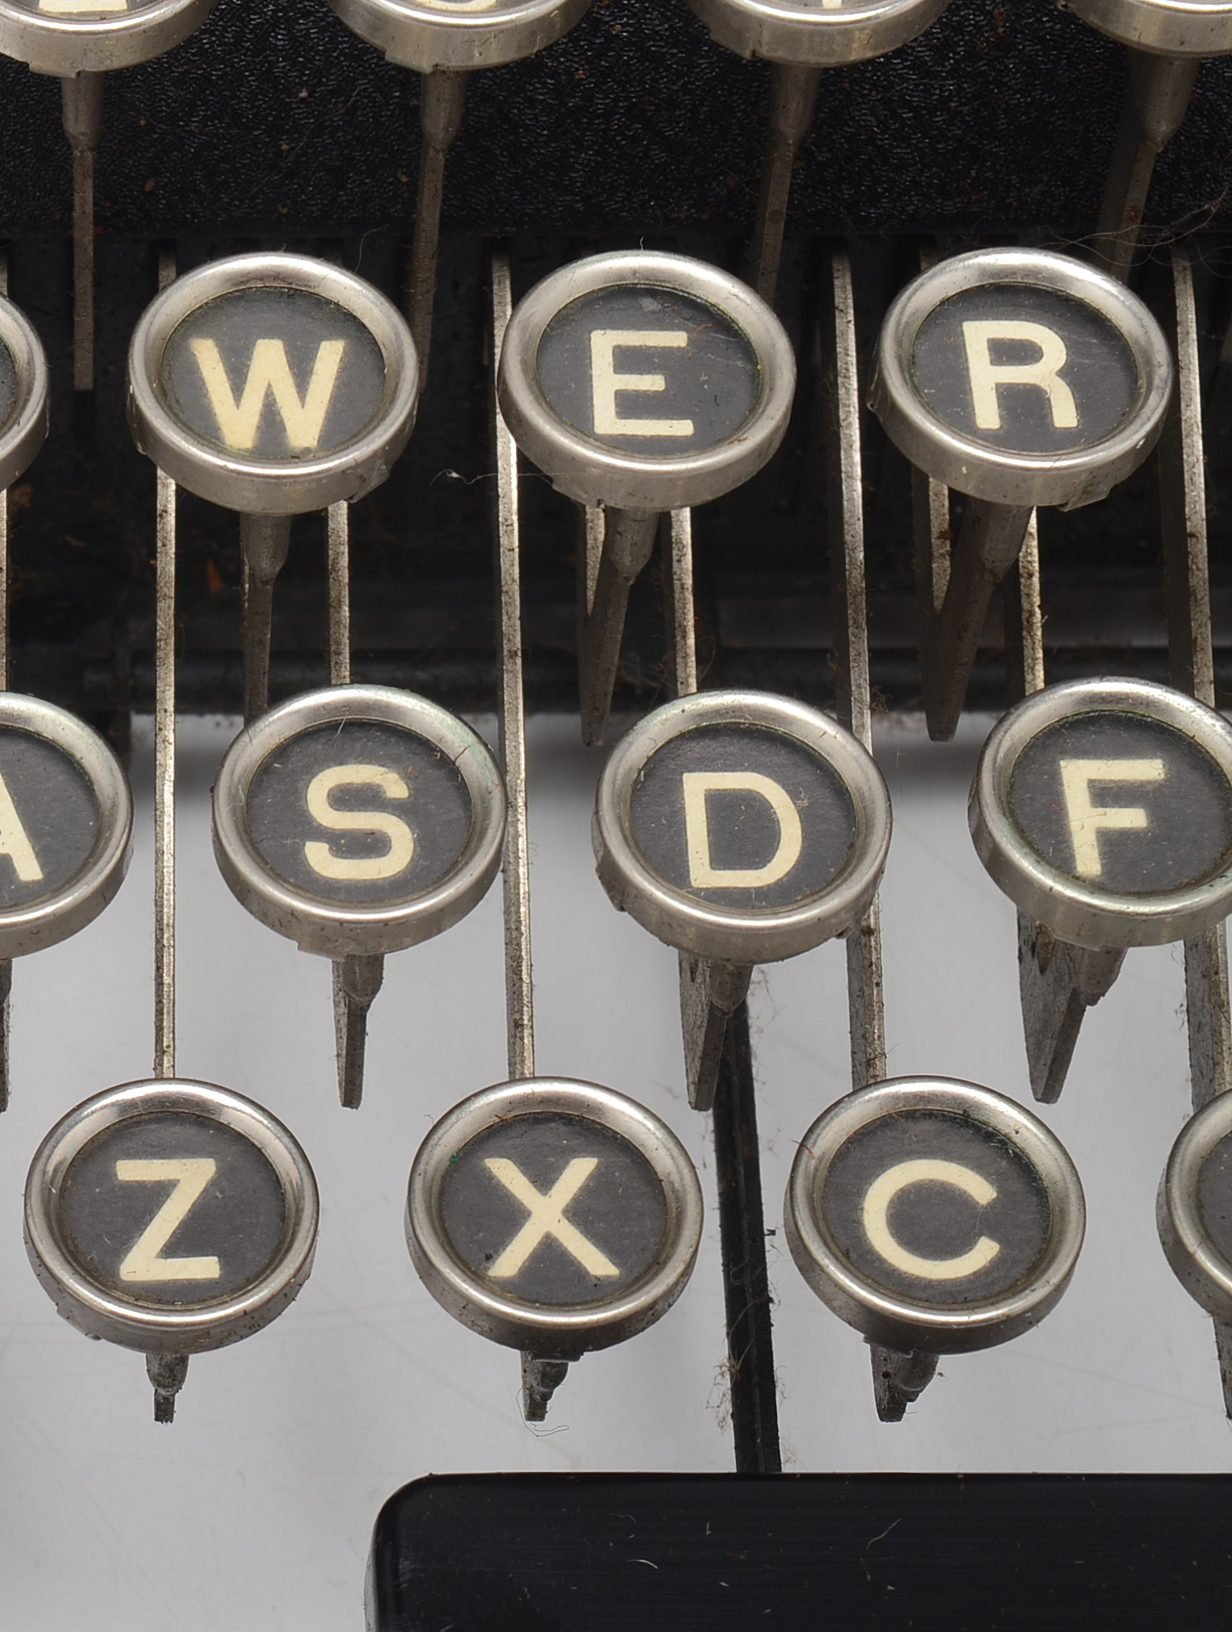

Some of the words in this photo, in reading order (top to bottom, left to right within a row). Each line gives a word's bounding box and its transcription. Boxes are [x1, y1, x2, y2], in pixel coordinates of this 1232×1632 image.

[187, 337, 346, 453] W
[588, 330, 694, 441] E
[960, 319, 1076, 432] R
[304, 763, 414, 882] S
[683, 771, 803, 890] D
[1059, 758, 1166, 878] F
[116, 1158, 221, 1282] Z
[484, 1157, 619, 1279] X
[863, 1160, 1000, 1278] C
